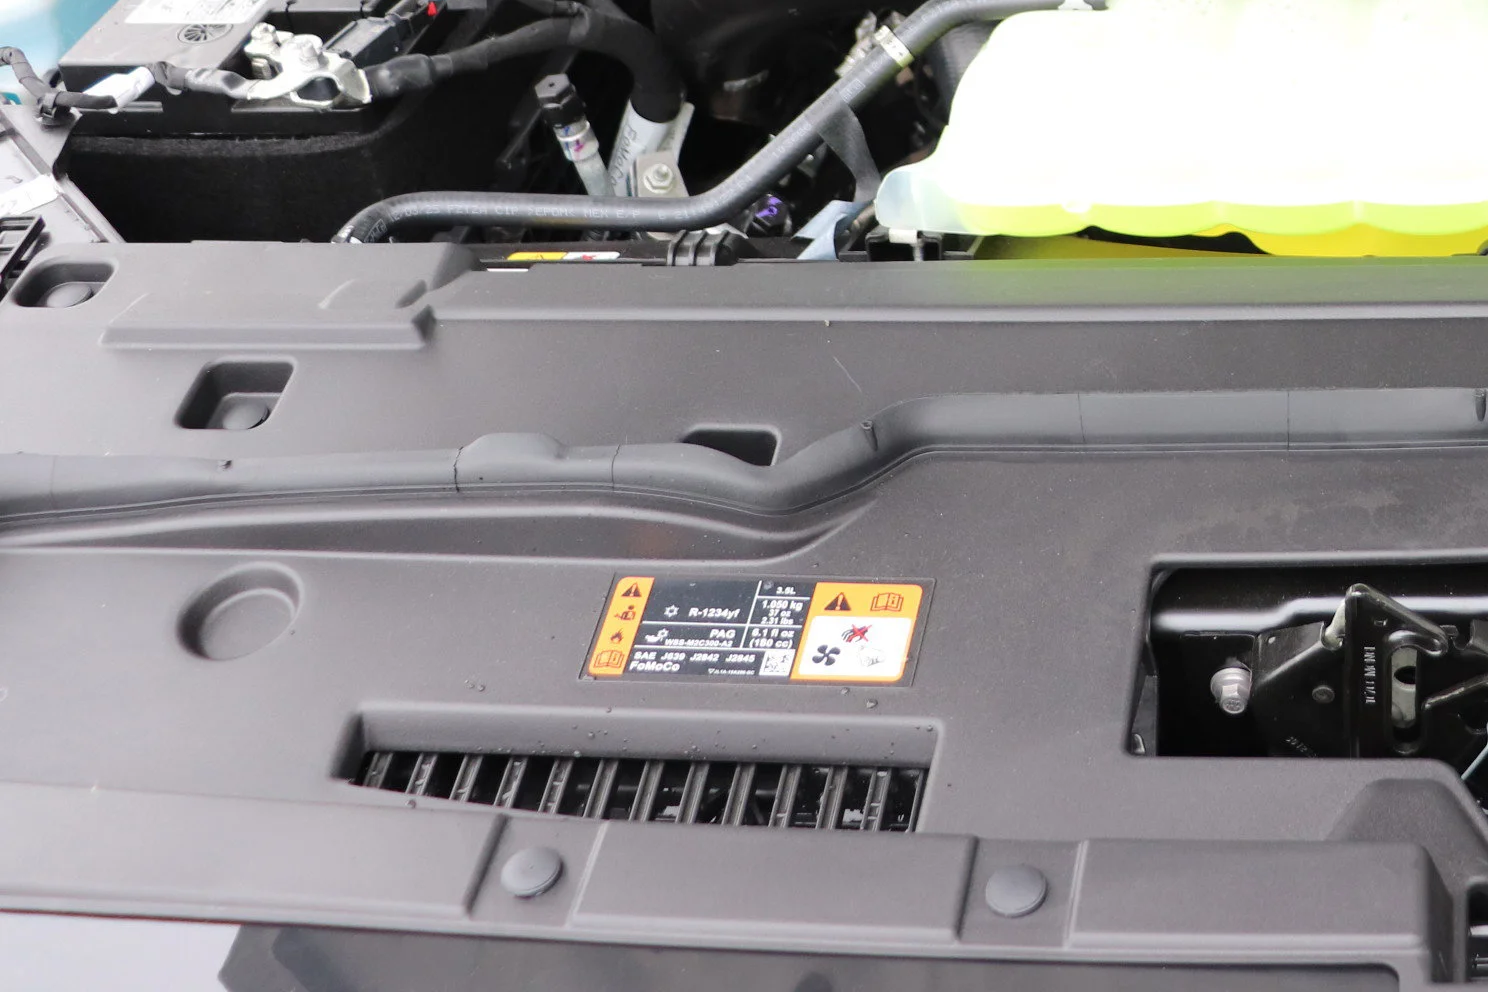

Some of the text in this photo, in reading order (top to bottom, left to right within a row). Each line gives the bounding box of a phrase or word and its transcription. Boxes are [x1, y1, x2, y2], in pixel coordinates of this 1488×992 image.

[762, 599, 804, 610] 1.050 kg
[688, 608, 741, 619] R-1234yf
[768, 609, 780, 617] 37
[760, 616, 794, 625] 2.31 lbs
[709, 628, 736, 639] PAG
[770, 628, 779, 637] fl
[781, 630, 795, 638] oz
[775, 639, 793, 649] cc)
[633, 651, 656, 660] SAE
[689, 653, 720, 662] J2842
[725, 654, 756, 663] J2845
[629, 660, 681, 672] FoMoCo
